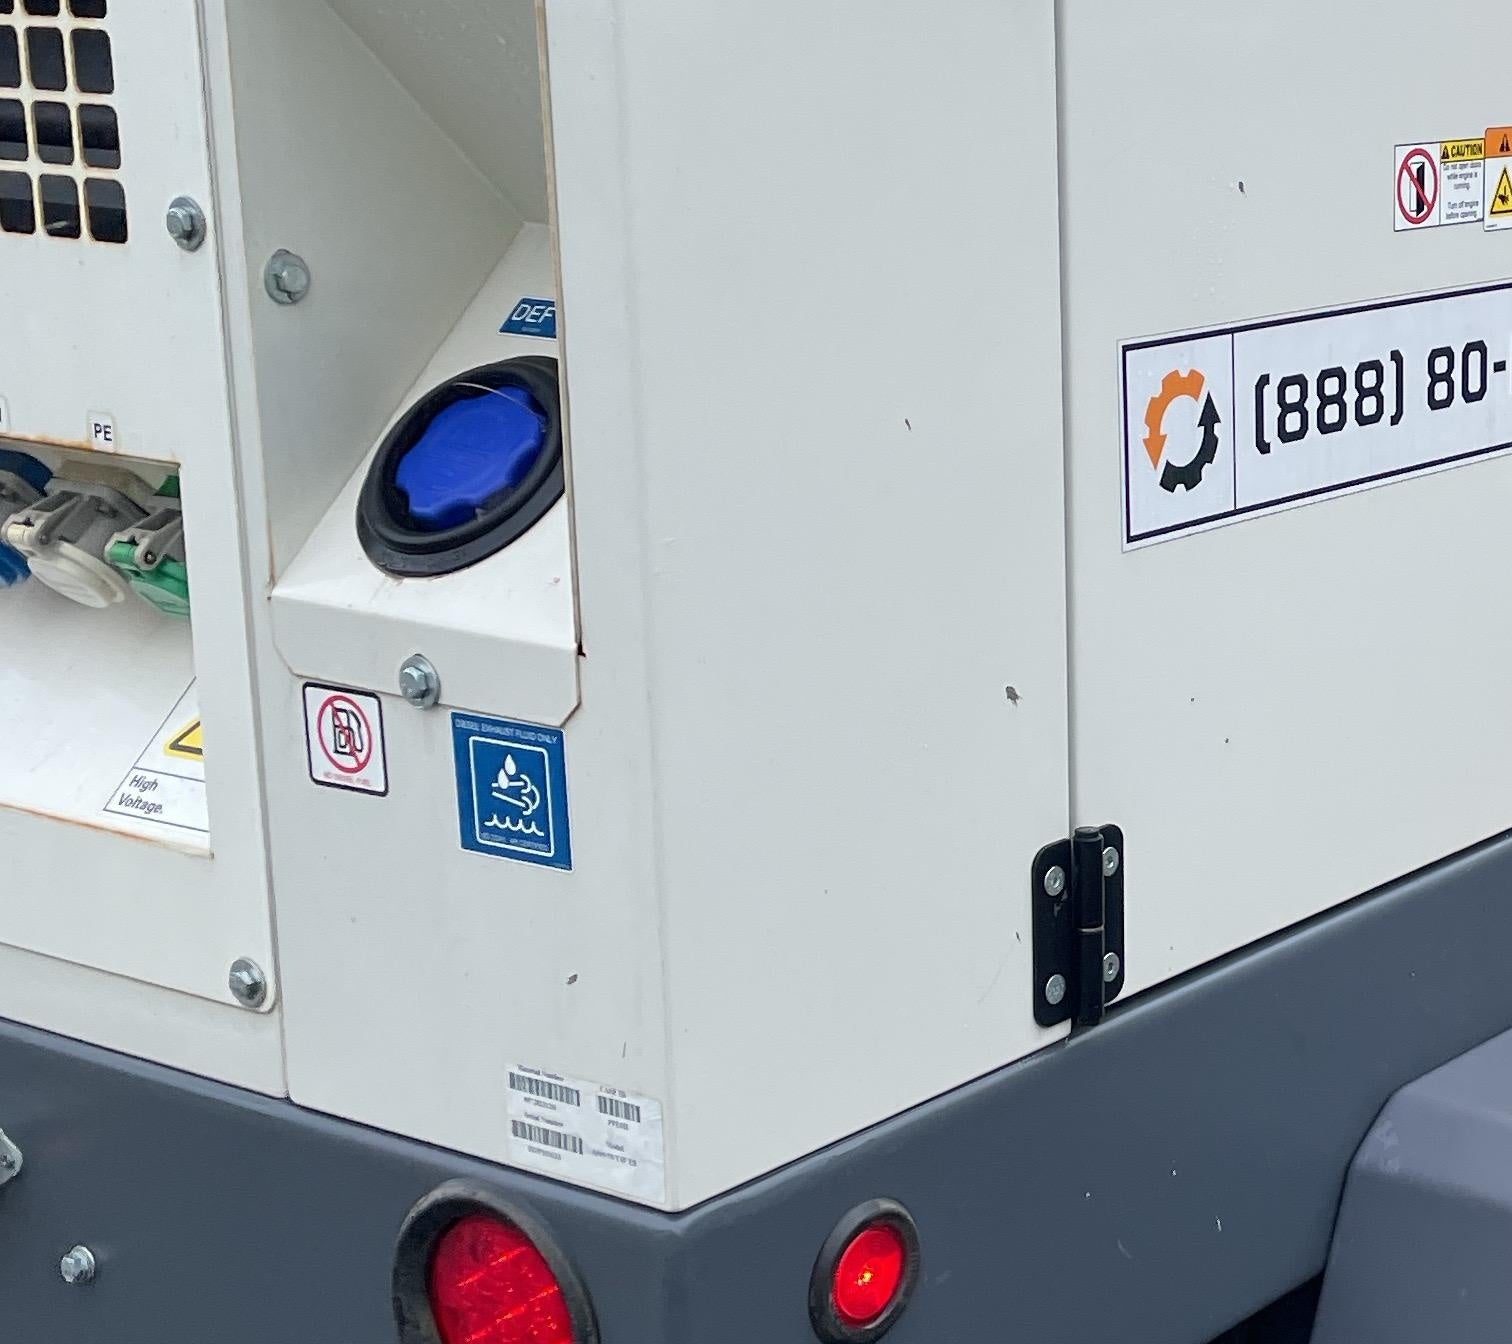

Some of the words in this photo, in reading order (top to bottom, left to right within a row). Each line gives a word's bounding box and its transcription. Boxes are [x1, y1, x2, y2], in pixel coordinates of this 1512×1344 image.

[1450, 142, 1483, 158] CAUTION
[511, 304, 556, 324] DEF
[1254, 348, 1405, 455] (888)
[93, 422, 113, 442] PE
[128, 773, 158, 793] High
